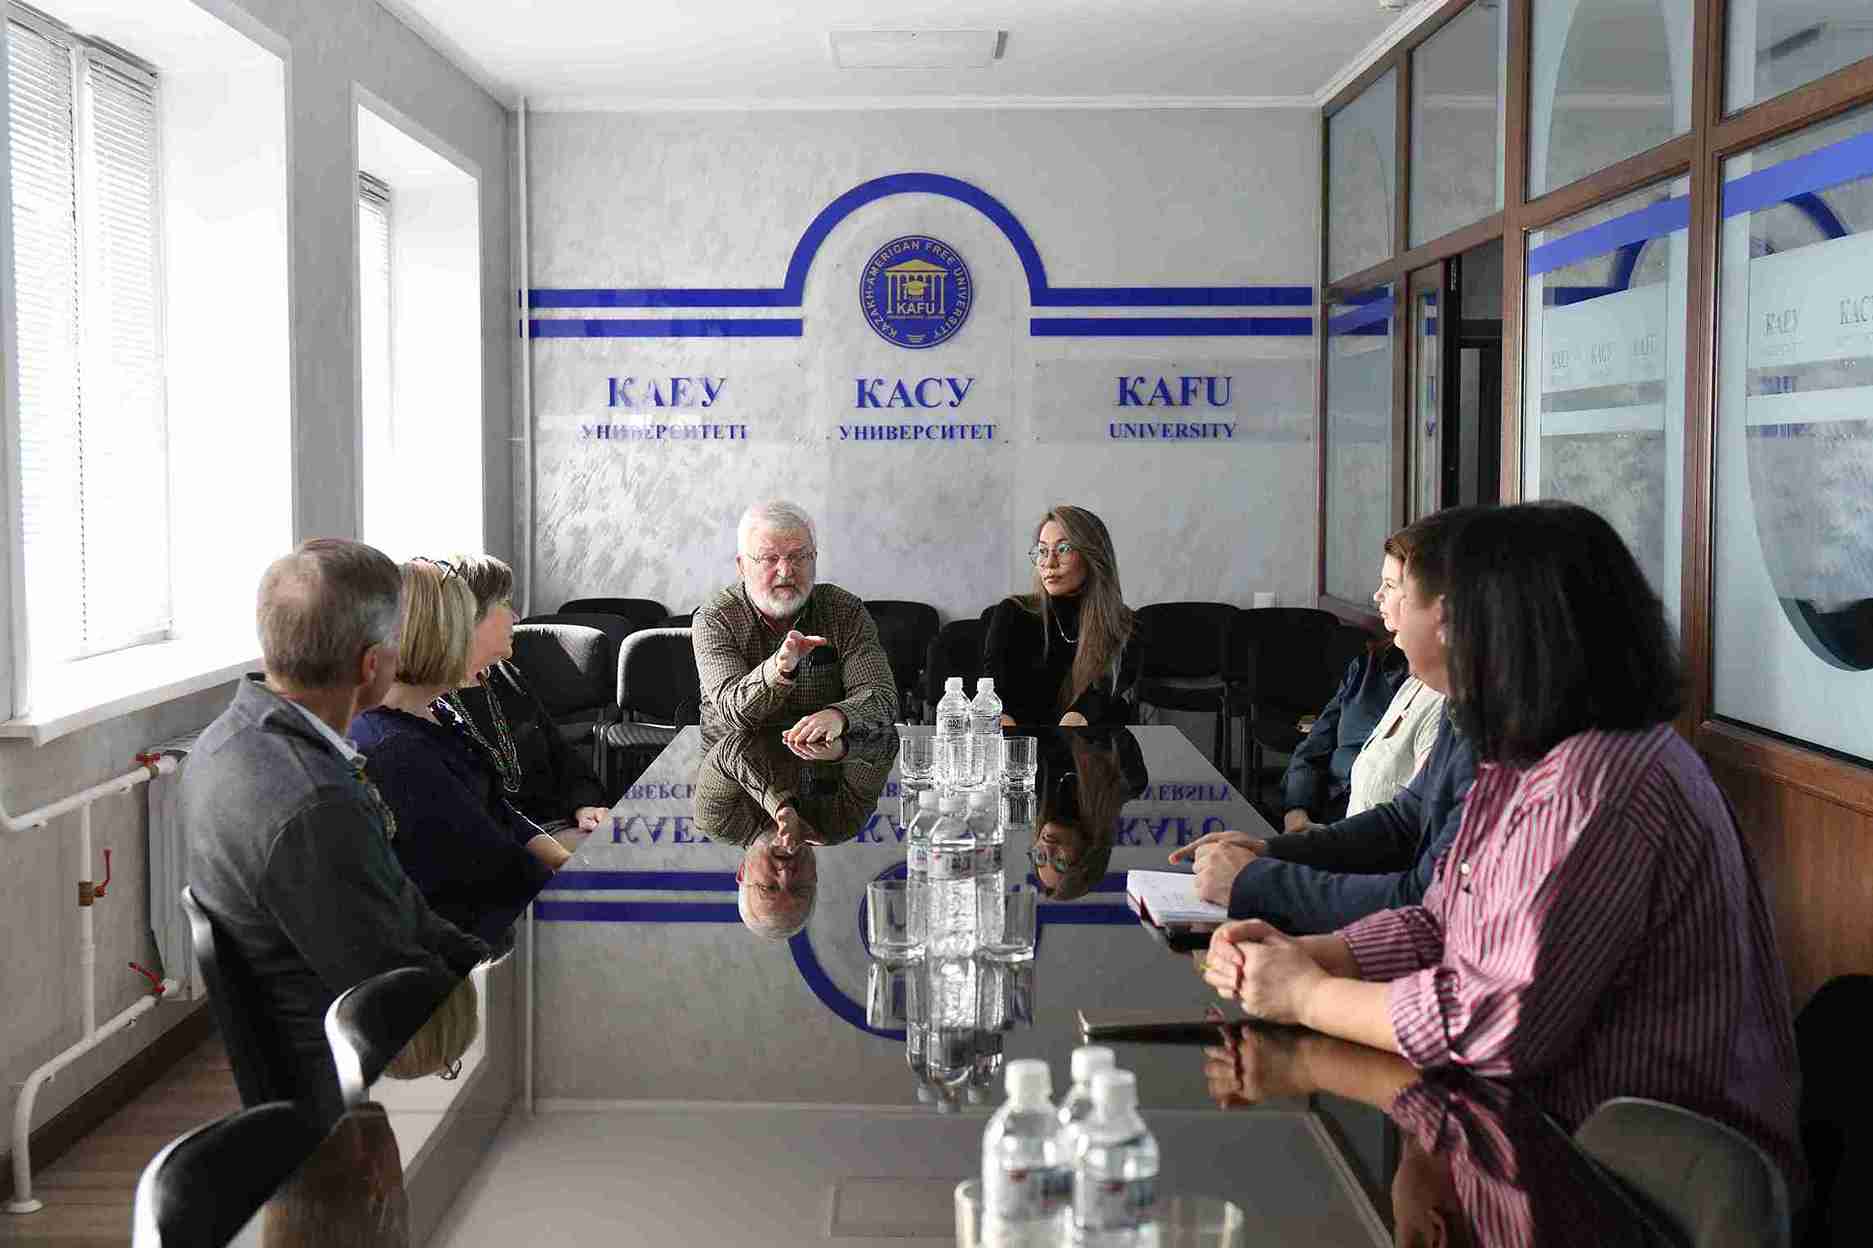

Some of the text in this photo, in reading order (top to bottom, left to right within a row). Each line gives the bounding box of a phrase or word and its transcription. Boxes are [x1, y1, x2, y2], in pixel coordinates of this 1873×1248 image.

[926, 242, 955, 266] FREE
[896, 302, 935, 315] KAFU
[855, 377, 975, 408] КАСУ
[1114, 376, 1232, 407] KAFU
[839, 424, 997, 440] УНИВЕРСИТЕТ
[1110, 423, 1237, 439] UNIVERSITY
